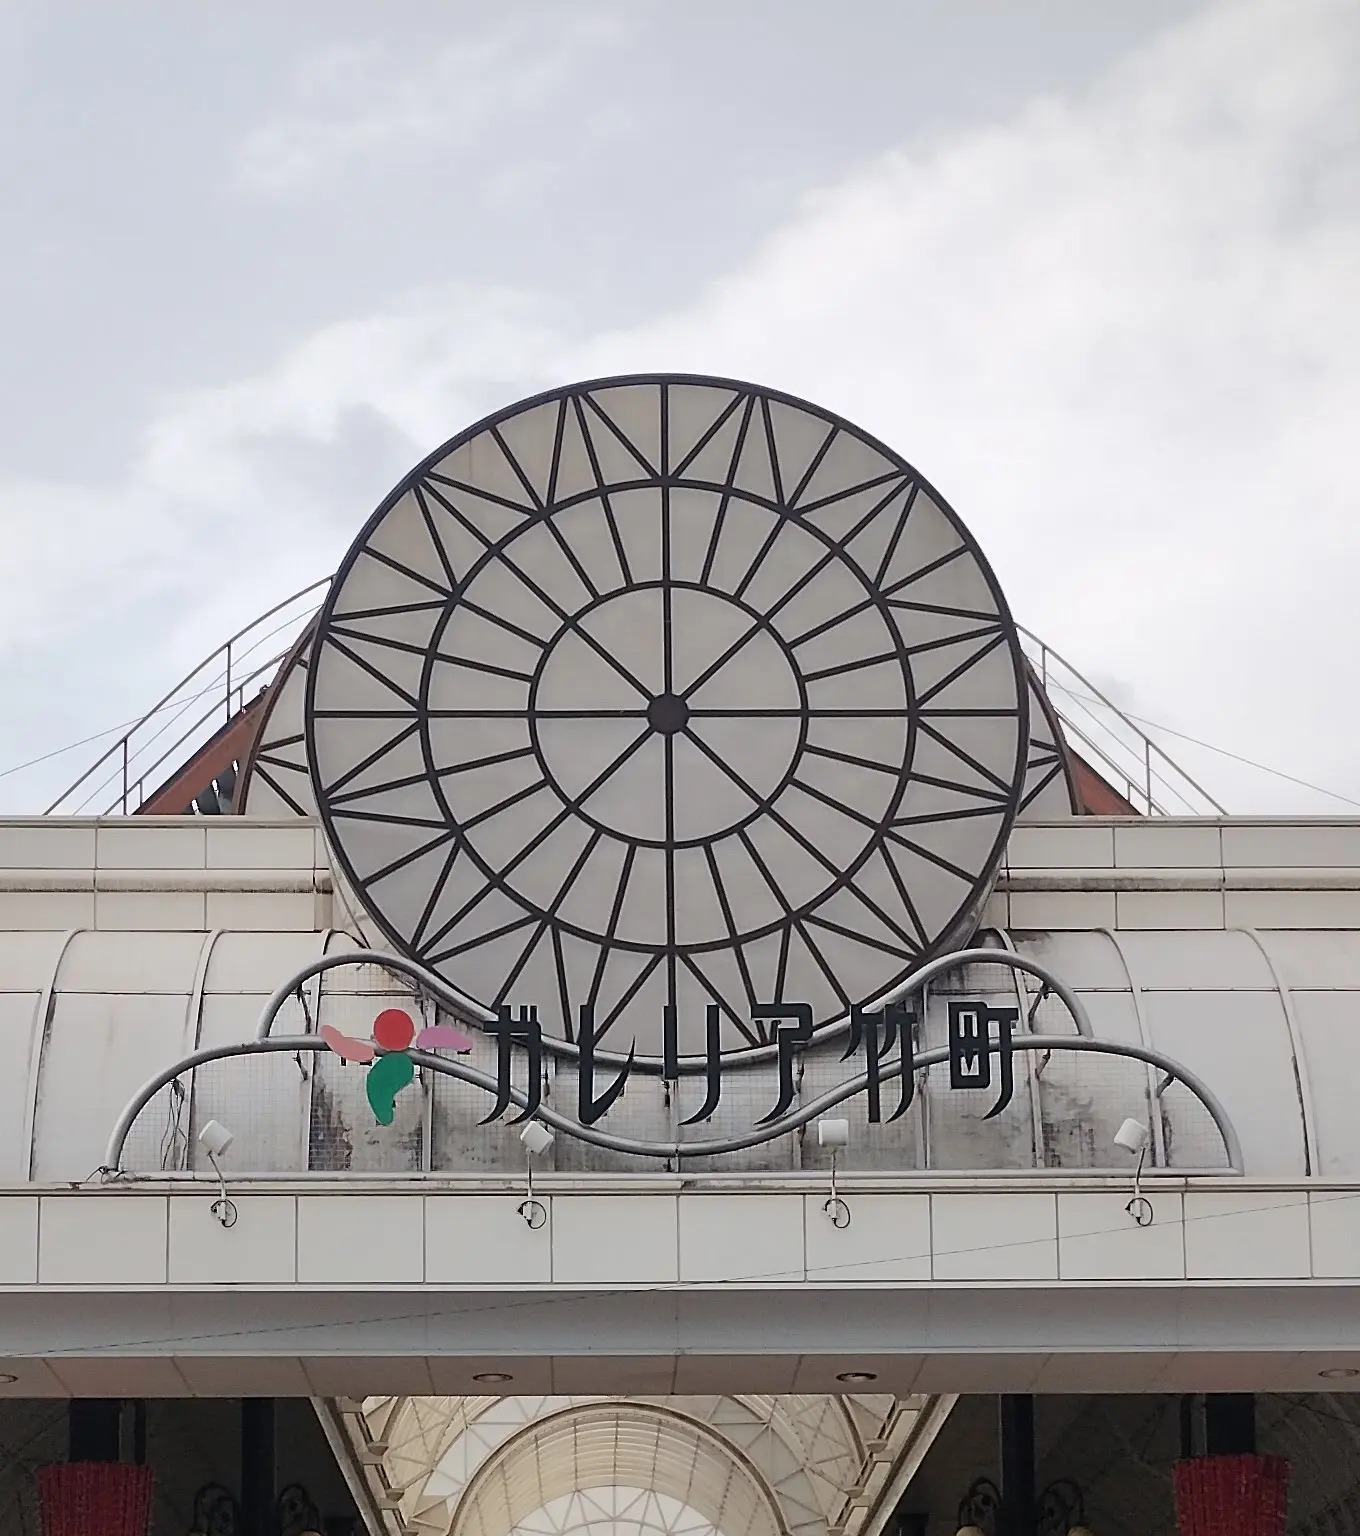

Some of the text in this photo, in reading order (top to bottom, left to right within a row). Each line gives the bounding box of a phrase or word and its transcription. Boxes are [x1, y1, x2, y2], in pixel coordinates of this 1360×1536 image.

[478, 1002, 1018, 1126] ガレリア竹町
